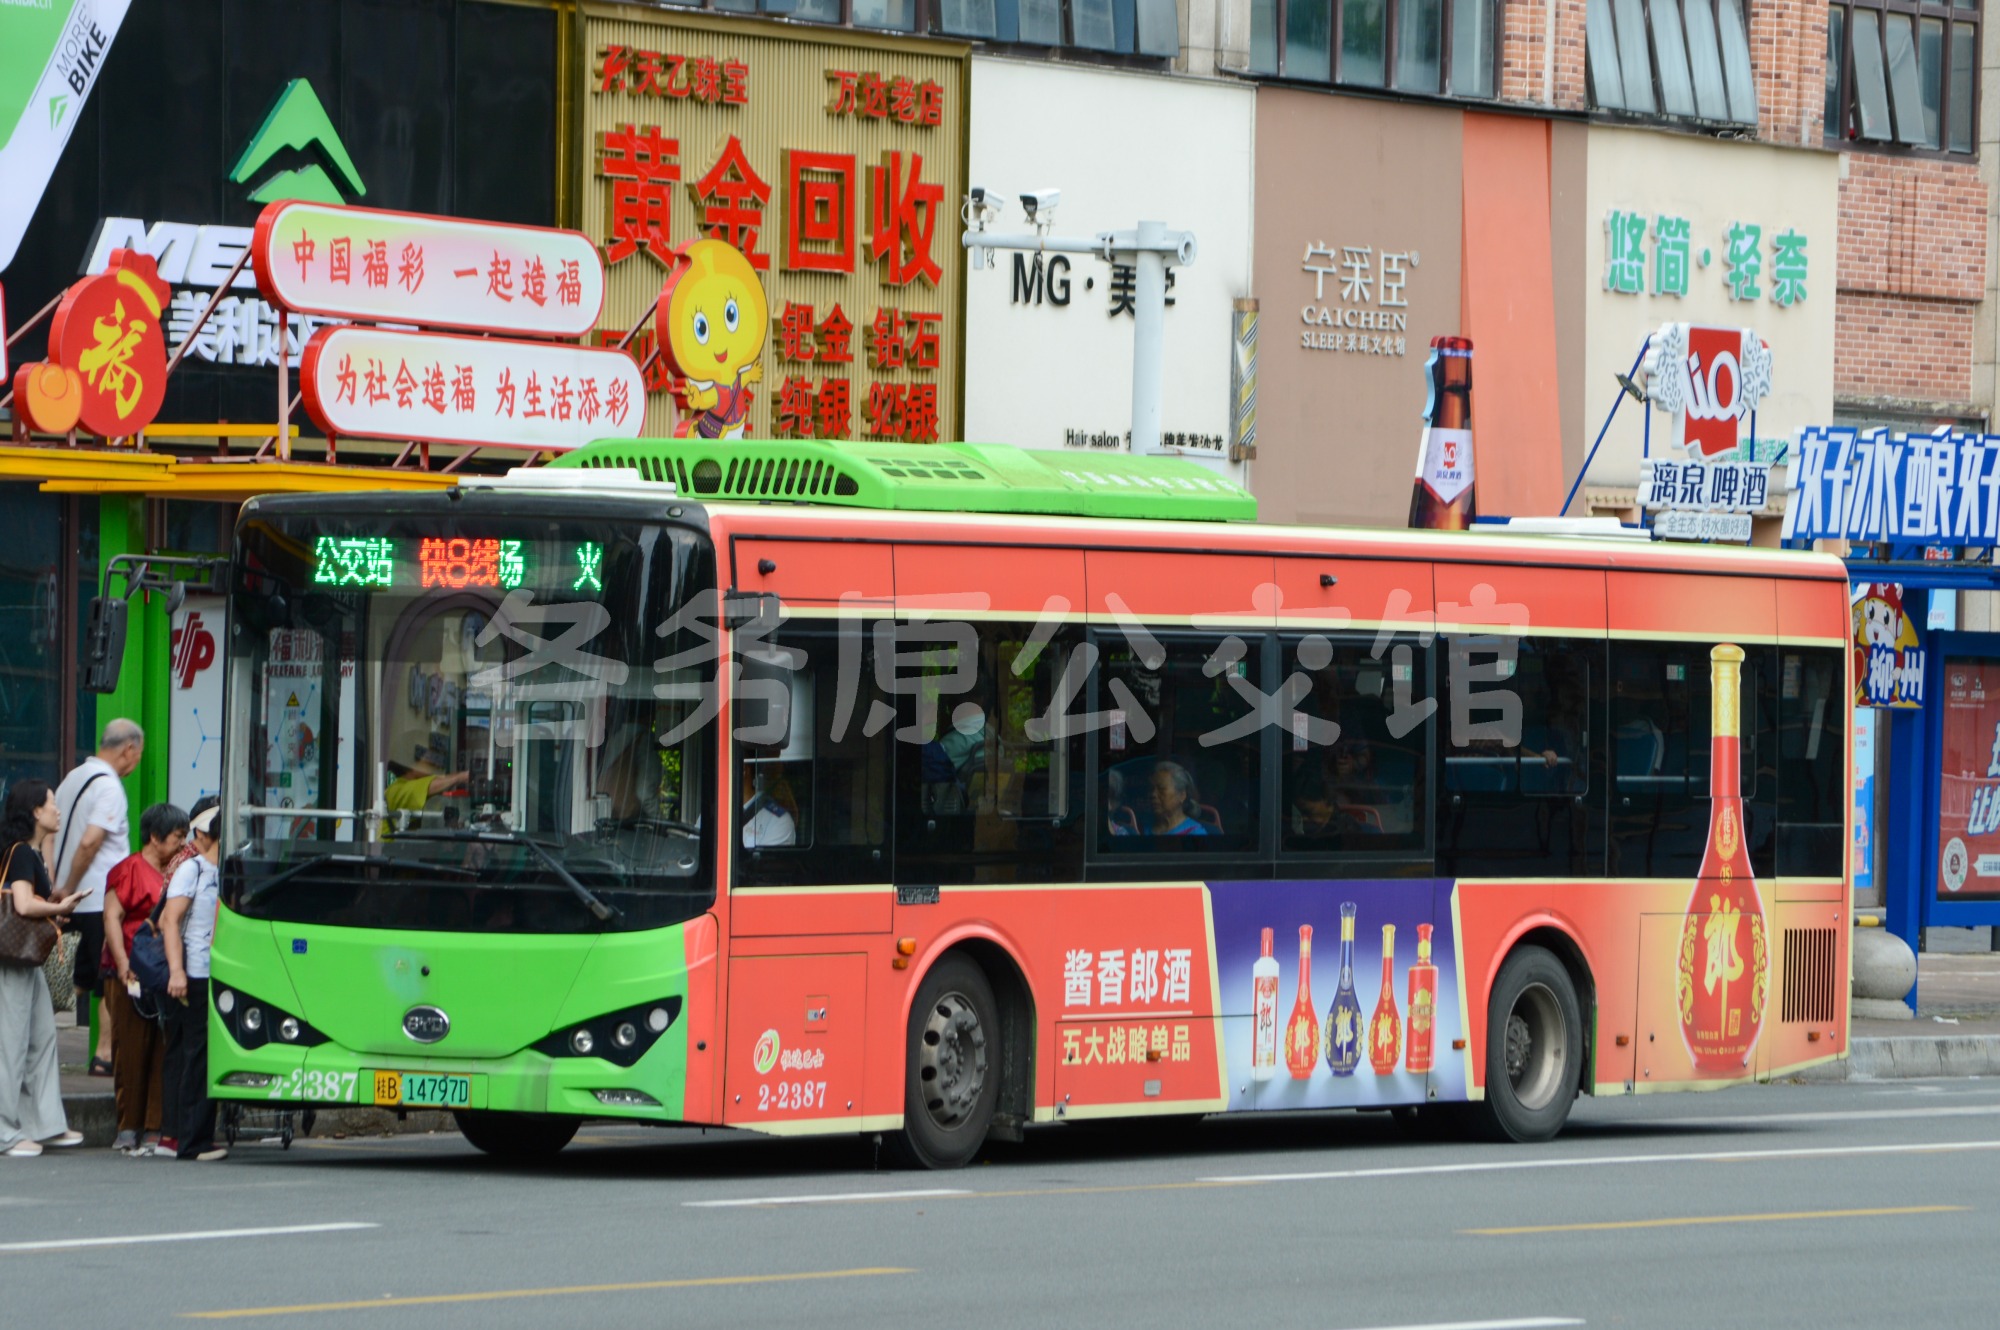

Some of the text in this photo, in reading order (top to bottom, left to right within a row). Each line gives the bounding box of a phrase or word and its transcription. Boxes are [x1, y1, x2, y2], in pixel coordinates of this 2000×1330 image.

[68, 22, 107, 97] BIKE
[833, 69, 944, 127] 万达老店
[604, 124, 944, 289] 黄金回收
[293, 228, 582, 307] 中国福彩 一起造福
[1302, 239, 1409, 307] 宁采臣
[1605, 211, 1808, 306] 悠简·轻奈
[779, 300, 854, 364] 钯金
[872, 306, 944, 369] 钻石
[1301, 305, 1408, 332] CAICHEN
[1302, 331, 1343, 351] SLEEP
[336, 353, 630, 427] 为社会造福 为生活添彩
[779, 375, 852, 439] 纯银
[869, 381, 940, 441] 925银
[1066, 429, 1088, 447] Hair
[1090, 431, 1121, 448] salon
[1650, 462, 1769, 506] 漓泉啤酒
[314, 536, 392, 586] 公交站
[573, 541, 603, 591] 火
[1869, 647, 1925, 701] 柳州
[1063, 949, 1193, 1008] 酱香郎酒
[406, 1015, 444, 1034] BYD
[1062, 1024, 1191, 1066] 五大战略单品
[269, 1069, 358, 1102] 2-2387
[376, 1076, 469, 1105] 桂B 14797D
[758, 1080, 827, 1111] 2-2387
